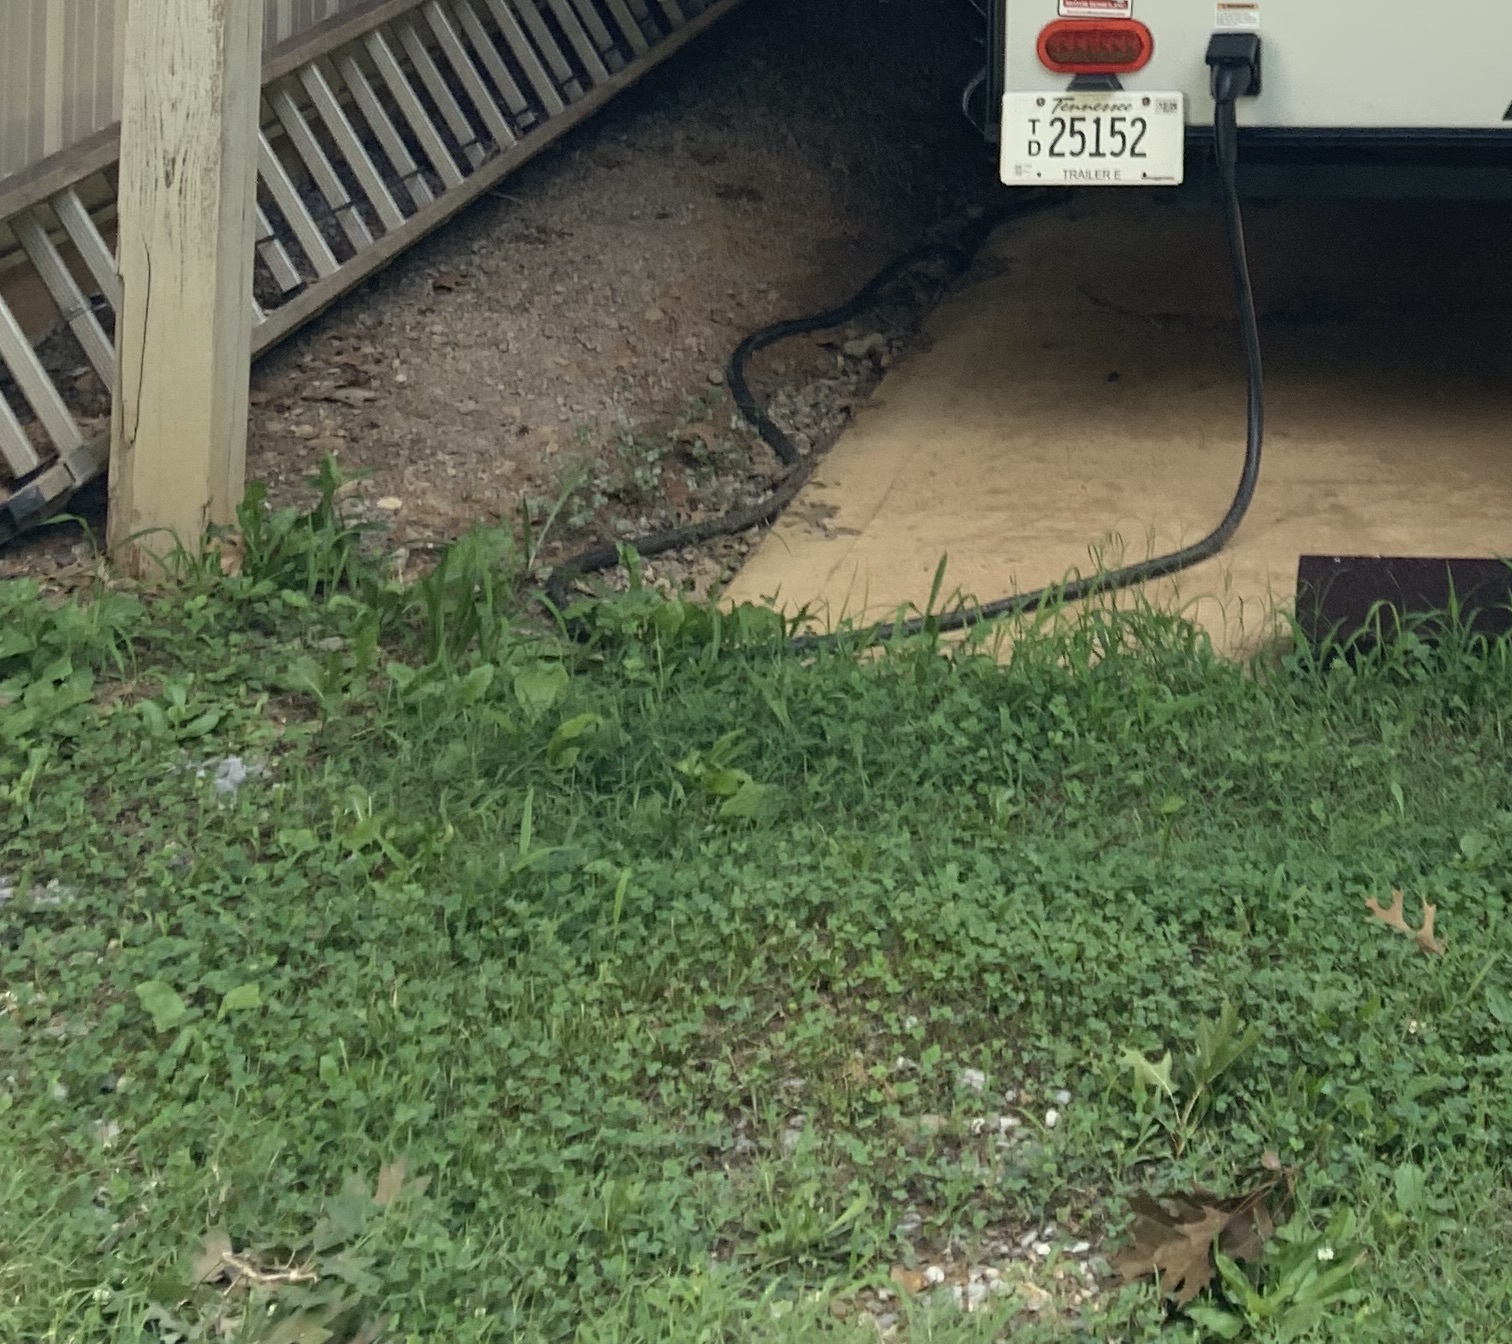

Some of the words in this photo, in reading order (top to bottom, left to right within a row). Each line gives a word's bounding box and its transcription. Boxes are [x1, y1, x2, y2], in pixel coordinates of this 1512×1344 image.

[1051, 97, 1132, 114] Tennessee
[1049, 116, 1147, 158] 25152
[1063, 169, 1111, 181] TRAILER
[1114, 170, 1122, 181] E
